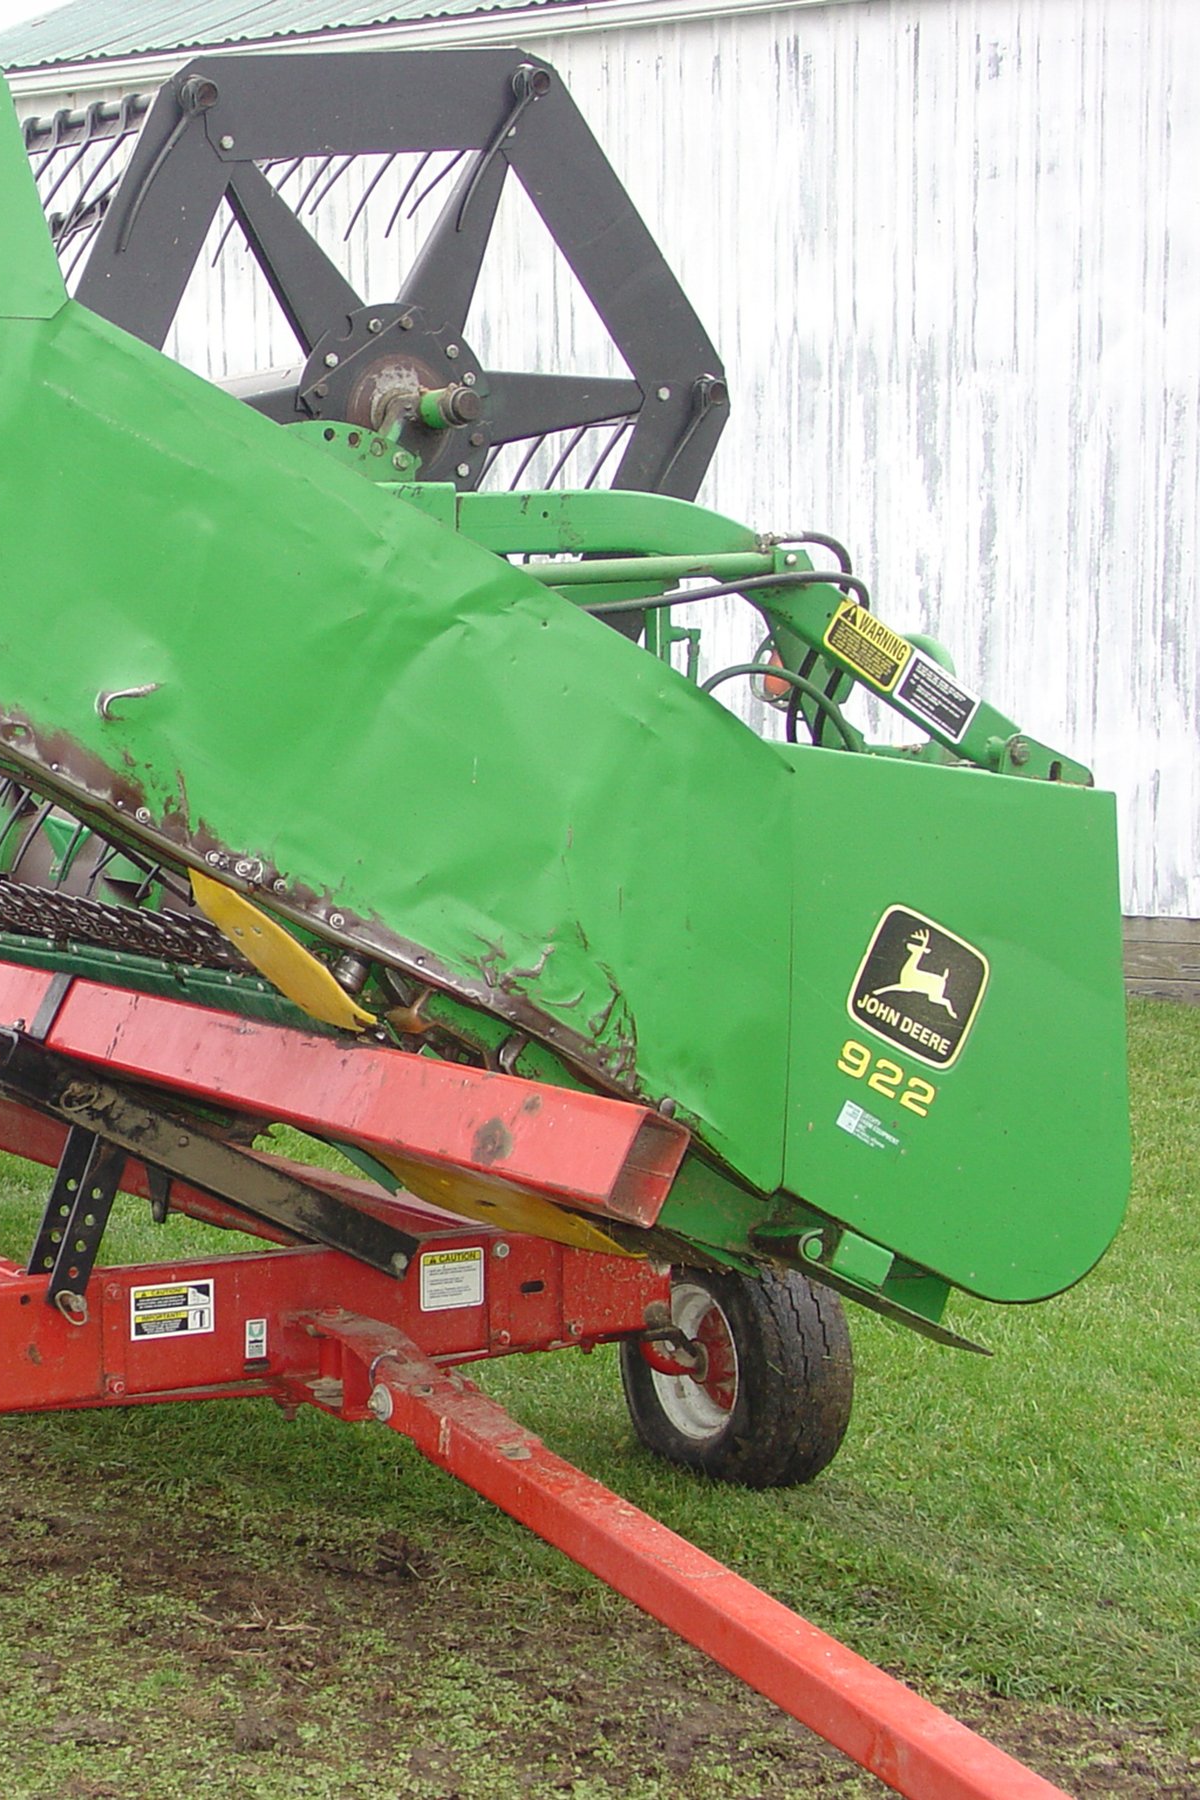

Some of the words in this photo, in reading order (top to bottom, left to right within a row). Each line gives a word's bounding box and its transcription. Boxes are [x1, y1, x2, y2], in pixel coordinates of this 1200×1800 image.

[858, 613, 908, 661] WARNING
[857, 994, 900, 1027] JOHN
[899, 1016, 951, 1055] DEERE
[836, 1039, 936, 1117] 922
[439, 1251, 476, 1263] CAUTION
